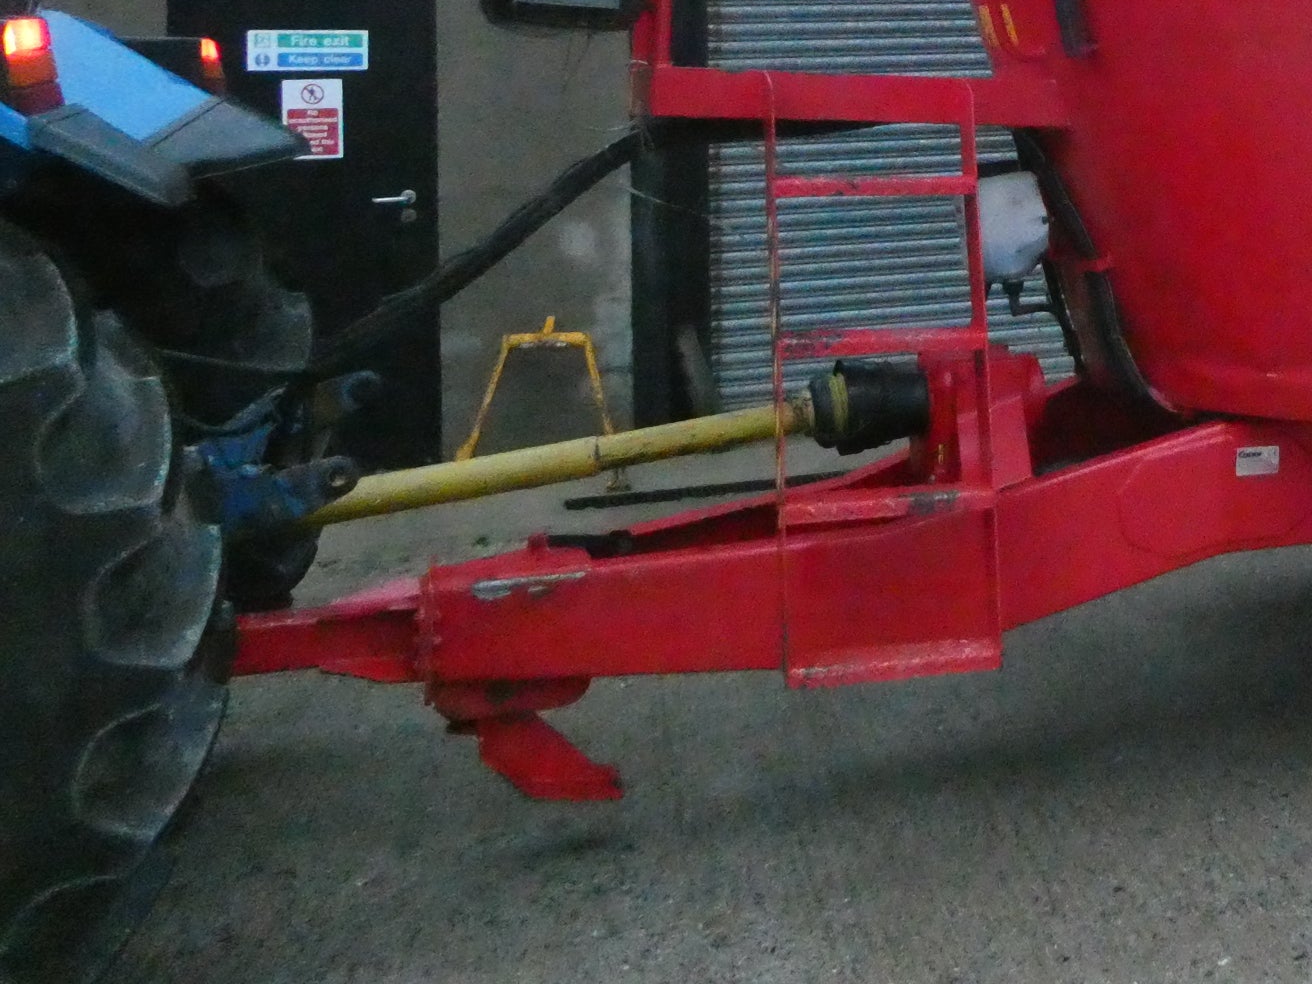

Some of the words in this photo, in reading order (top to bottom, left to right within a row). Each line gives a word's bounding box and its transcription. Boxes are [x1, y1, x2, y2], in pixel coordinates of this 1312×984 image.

[291, 36, 318, 46] Fire
[323, 36, 349, 46] exit
[288, 54, 319, 65] Keep
[323, 54, 352, 64] clear
